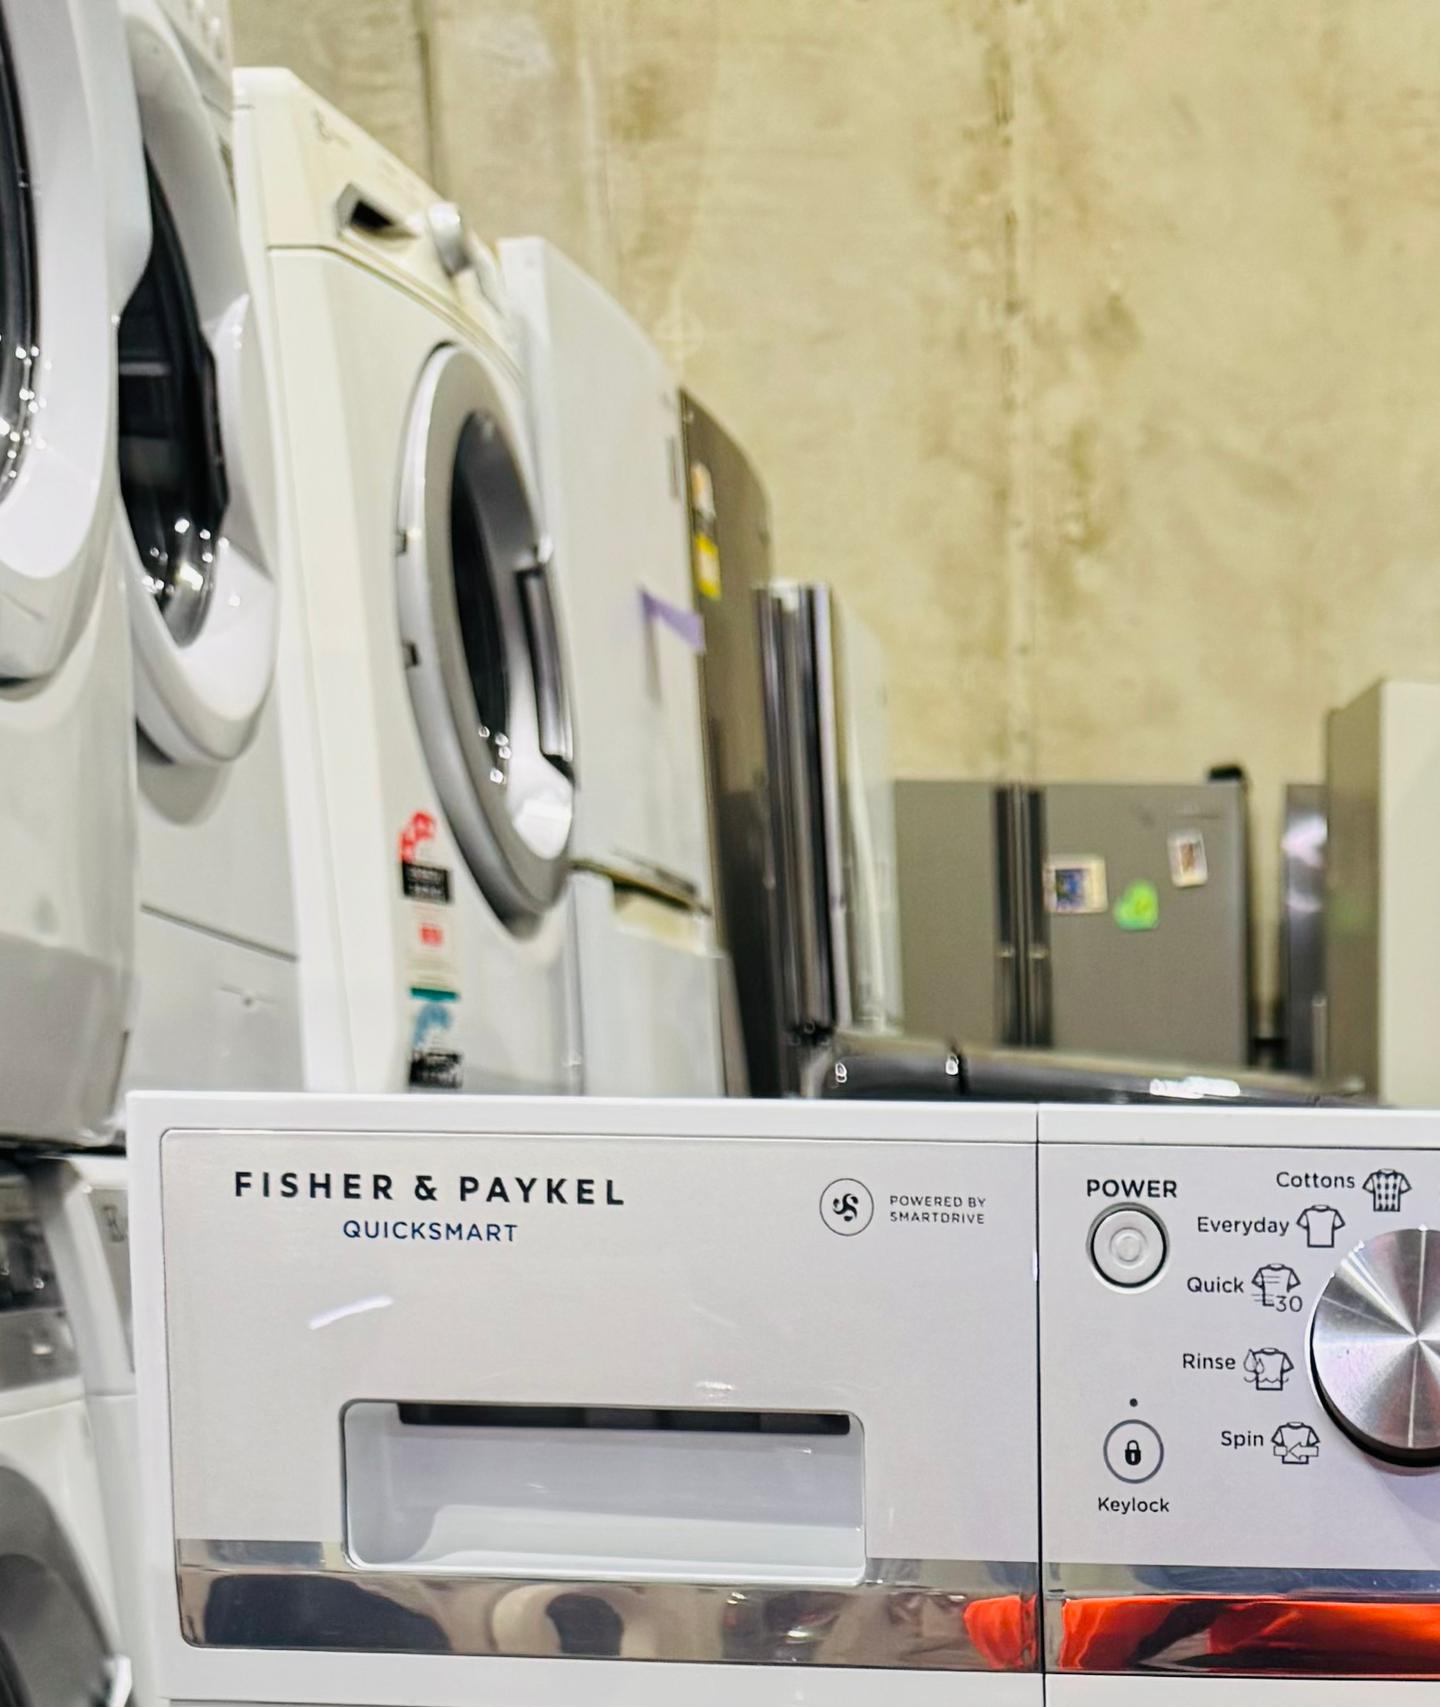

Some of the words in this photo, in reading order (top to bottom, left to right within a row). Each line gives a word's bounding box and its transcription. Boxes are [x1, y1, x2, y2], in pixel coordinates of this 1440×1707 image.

[235, 1171, 393, 1200] FISHER
[414, 1175, 437, 1201] &
[459, 1176, 624, 1206] PAYKEL
[1086, 1179, 1178, 1198] POWER
[1276, 1171, 1356, 1189] Cottons
[889, 1195, 963, 1208] POWERED
[967, 1196, 986, 1208] BY
[890, 1211, 985, 1225] SMARTDRIVE
[1196, 1216, 1290, 1237] Everyday
[343, 1219, 518, 1242] QUICKSMART
[1186, 1276, 1244, 1294] Quick
[1275, 1294, 1303, 1313] 30
[1182, 1352, 1236, 1370] Rinse
[1221, 1430, 1264, 1450] Spin
[1097, 1496, 1170, 1515] Keylock
